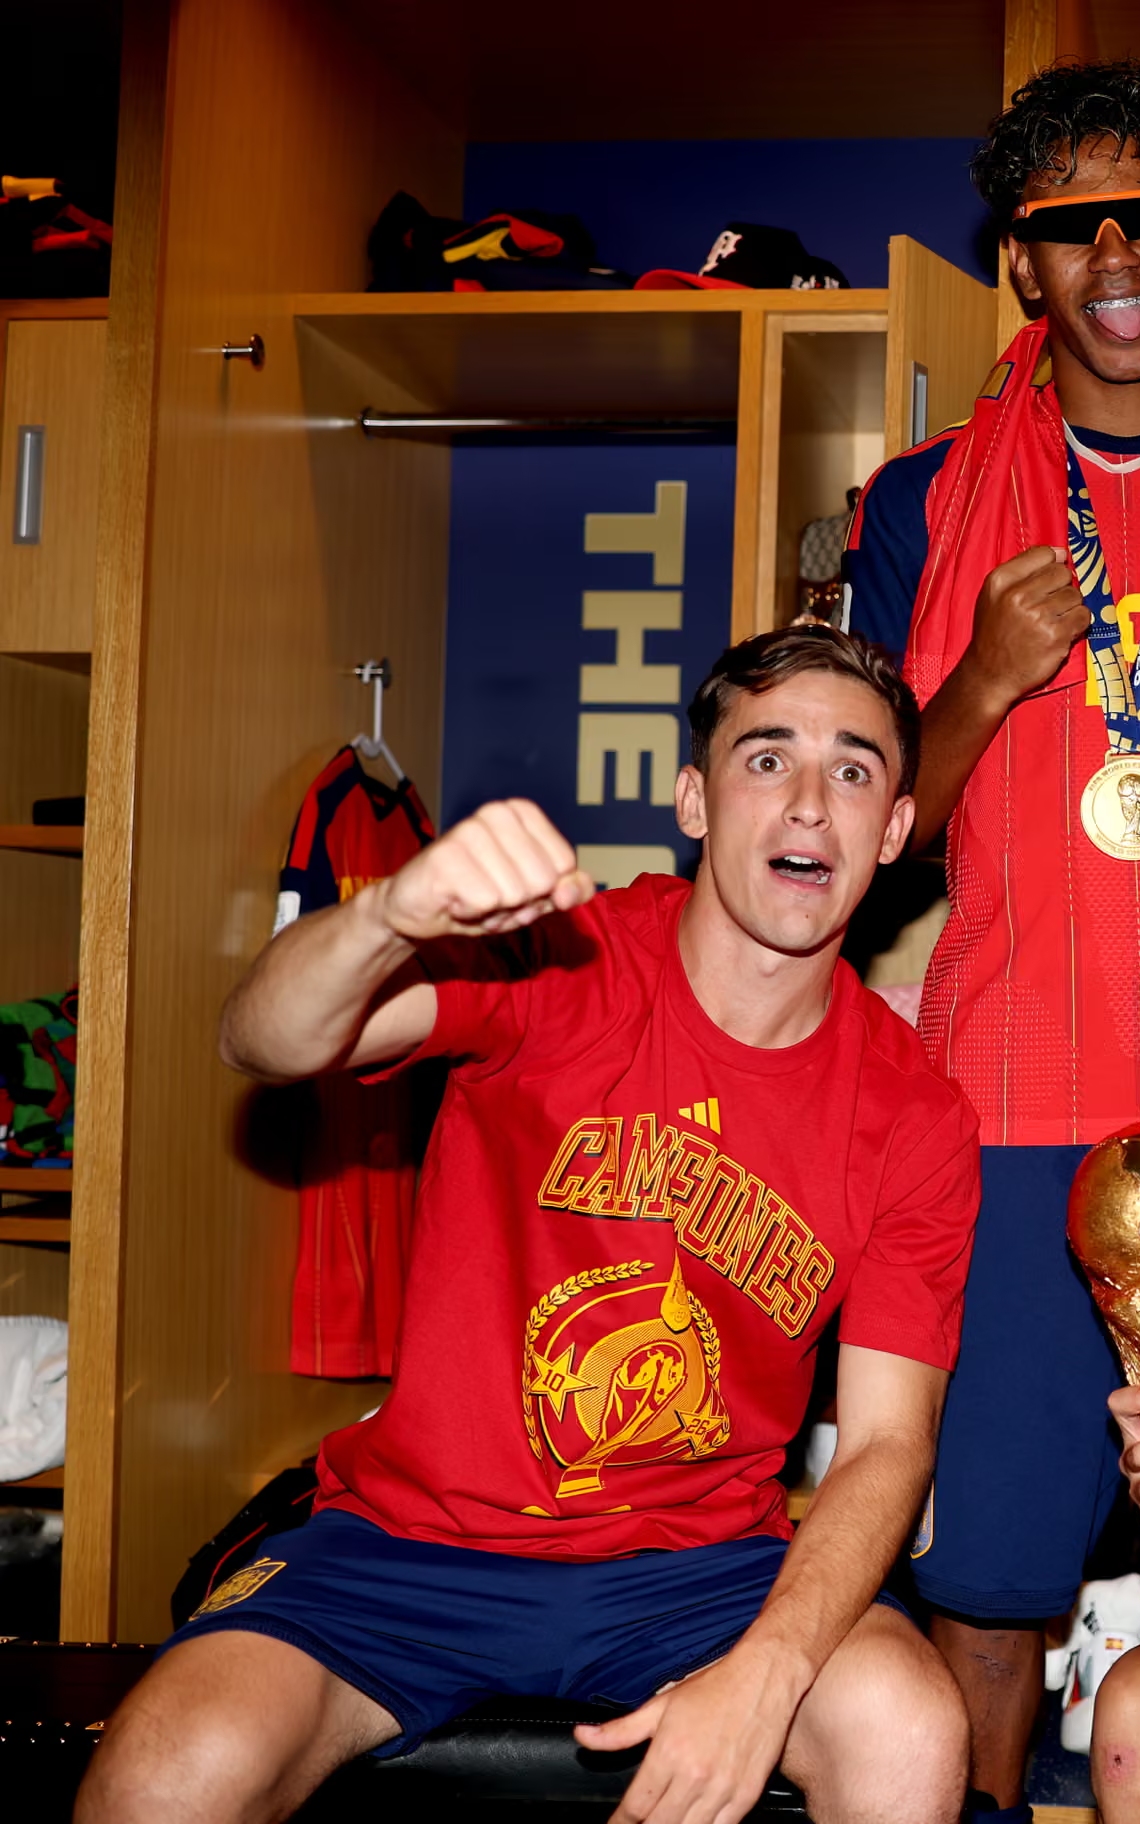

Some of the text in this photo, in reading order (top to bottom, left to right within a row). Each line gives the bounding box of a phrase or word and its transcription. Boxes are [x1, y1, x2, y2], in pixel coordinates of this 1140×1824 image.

[576, 480, 687, 806] THE
[537, 1112, 837, 1339] CAMEONES
[542, 1368, 565, 1392] 10
[685, 1418, 710, 1436] 26
